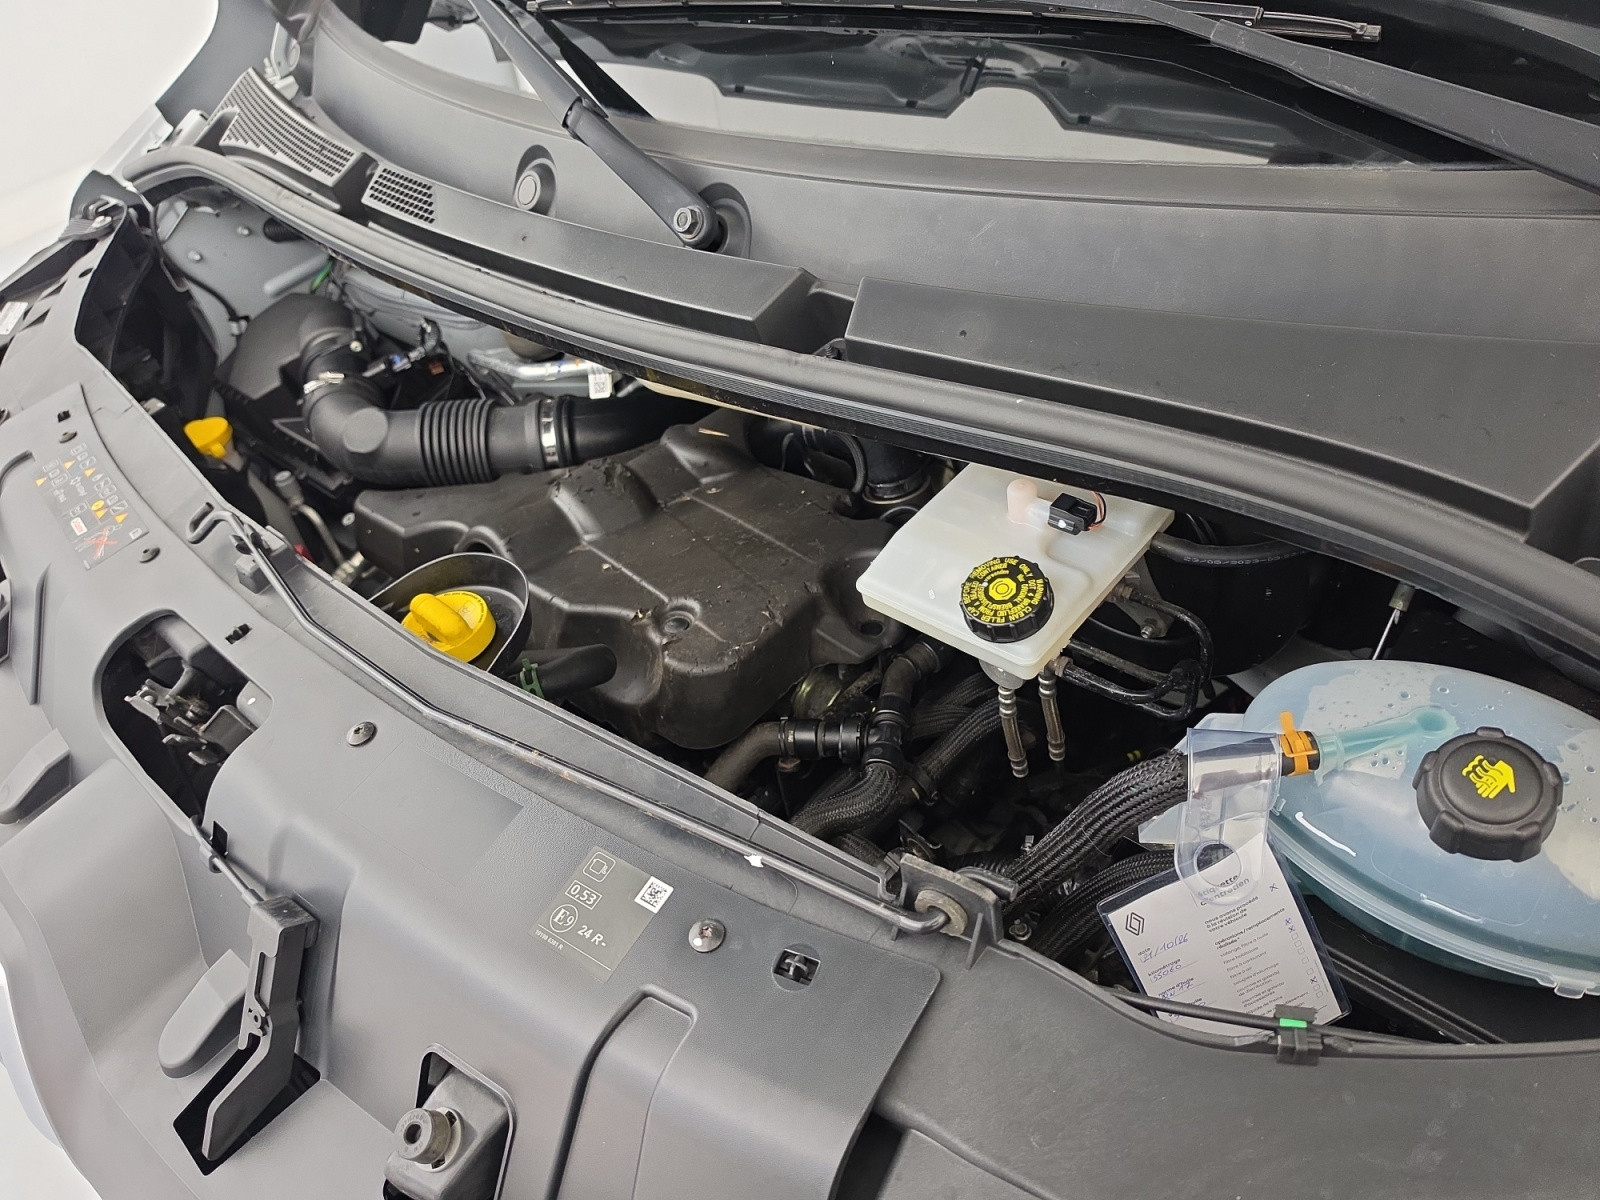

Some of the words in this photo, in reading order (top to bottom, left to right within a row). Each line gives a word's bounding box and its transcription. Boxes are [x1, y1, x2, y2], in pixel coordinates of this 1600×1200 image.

[970, 559, 1000, 578] REMOVING
[977, 563, 1008, 579] CONTAINER
[1019, 564, 1033, 577] ONLY
[963, 581, 971, 604] BEFORE
[970, 581, 979, 600] SEALED
[1028, 579, 1036, 590] DOT
[1031, 579, 1044, 605] WARNING
[967, 606, 979, 616] CAP
[978, 605, 995, 616] FROM
[981, 614, 1005, 623] FILLER
[1009, 606, 1032, 621] CLEAN
[570, 884, 597, 905] 0,53
[553, 908, 575, 926] E9
[577, 924, 593, 939] 24
[1147, 959, 1181, 976] kilométrage
